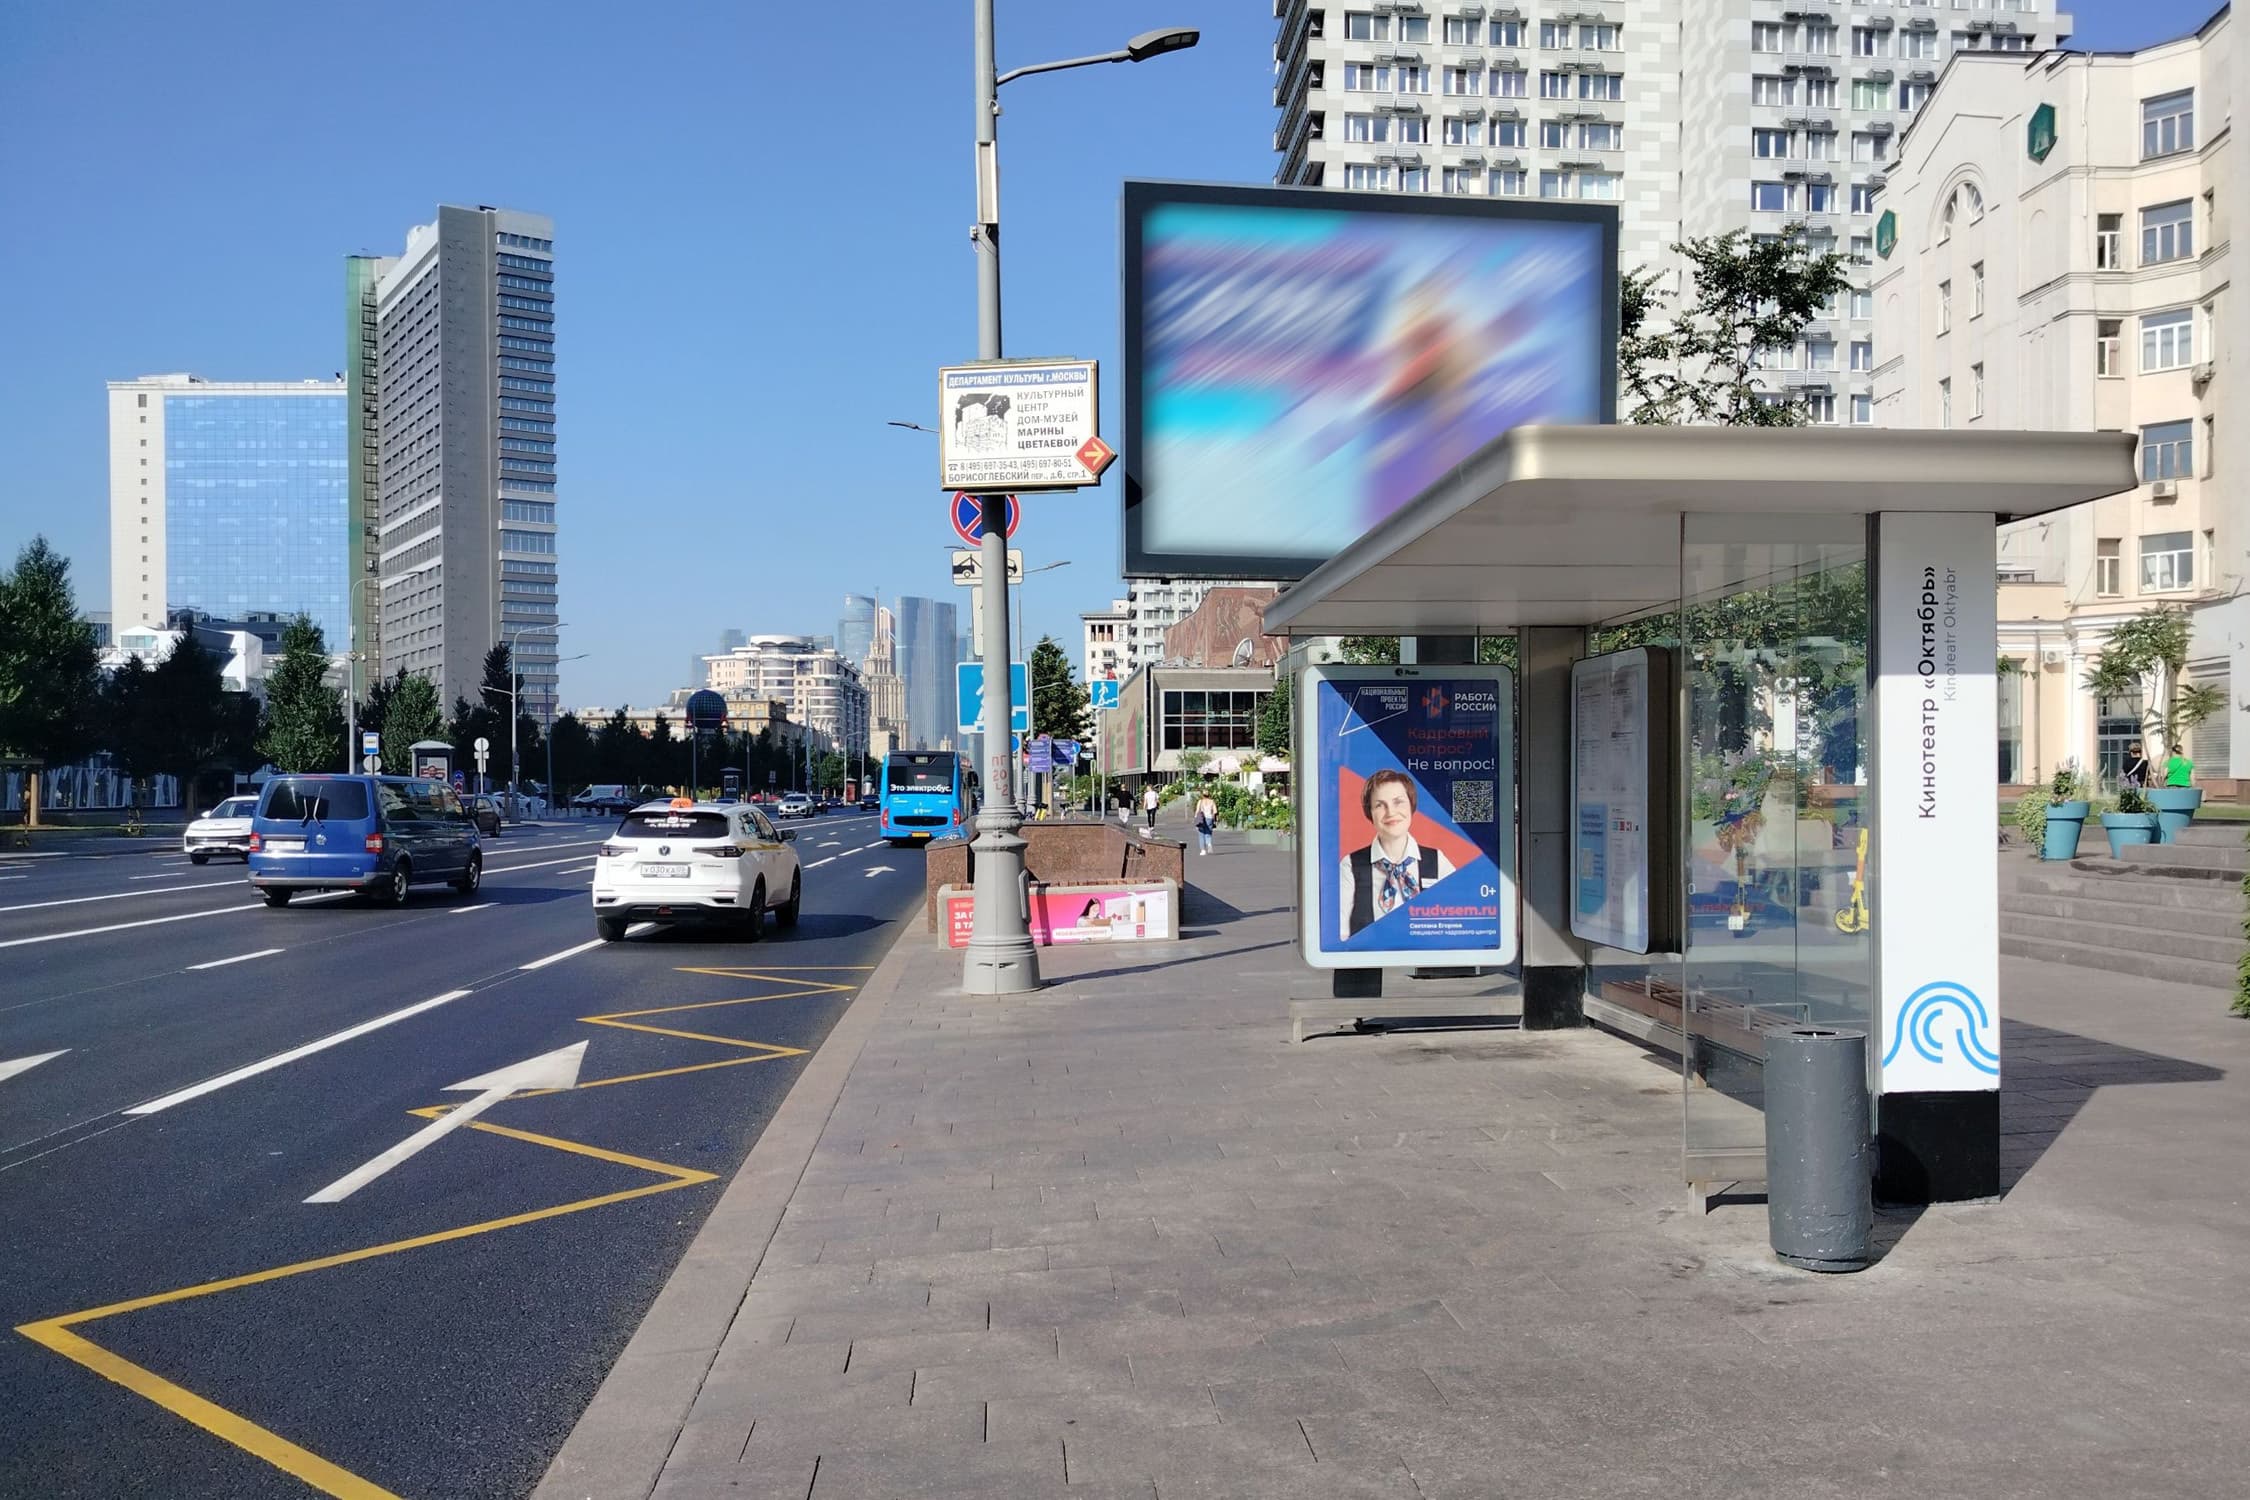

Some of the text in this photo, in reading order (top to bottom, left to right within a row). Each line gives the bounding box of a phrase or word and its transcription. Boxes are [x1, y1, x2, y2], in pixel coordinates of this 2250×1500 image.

[949, 376, 1001, 387] ДЕПАРТАМЕНТ
[1004, 373, 1044, 385] КУЛЬТУРЫ
[1017, 387, 1084, 400] КУЛЬТУРНЫЙ
[1017, 403, 1049, 413] ЦЕНТР
[1017, 412, 1078, 425] ДОМ-МУЗЕЙ
[1018, 427, 1064, 436] МАРИНЫ
[1018, 436, 1078, 449] ЦВЕТАЕВОЙ
[948, 470, 1029, 482] БОРИСОГЛЕБСКИЙ
[1944, 567, 1958, 701] Kinoteatr Oktyabr
[1454, 693, 1495, 701] РАБОТА
[1917, 566, 1939, 819] Кинотеатр «Октябрь»
[1454, 703, 1497, 711] РОССИИ
[1408, 728, 1488, 741] Кадровый
[1408, 742, 1473, 757] вопрос?
[1407, 758, 1495, 772] Не вопрос!
[890, 784, 952, 793] Это электробус.
[1480, 885, 1496, 897] 0+
[1409, 904, 1497, 917] trudvsem.ru
